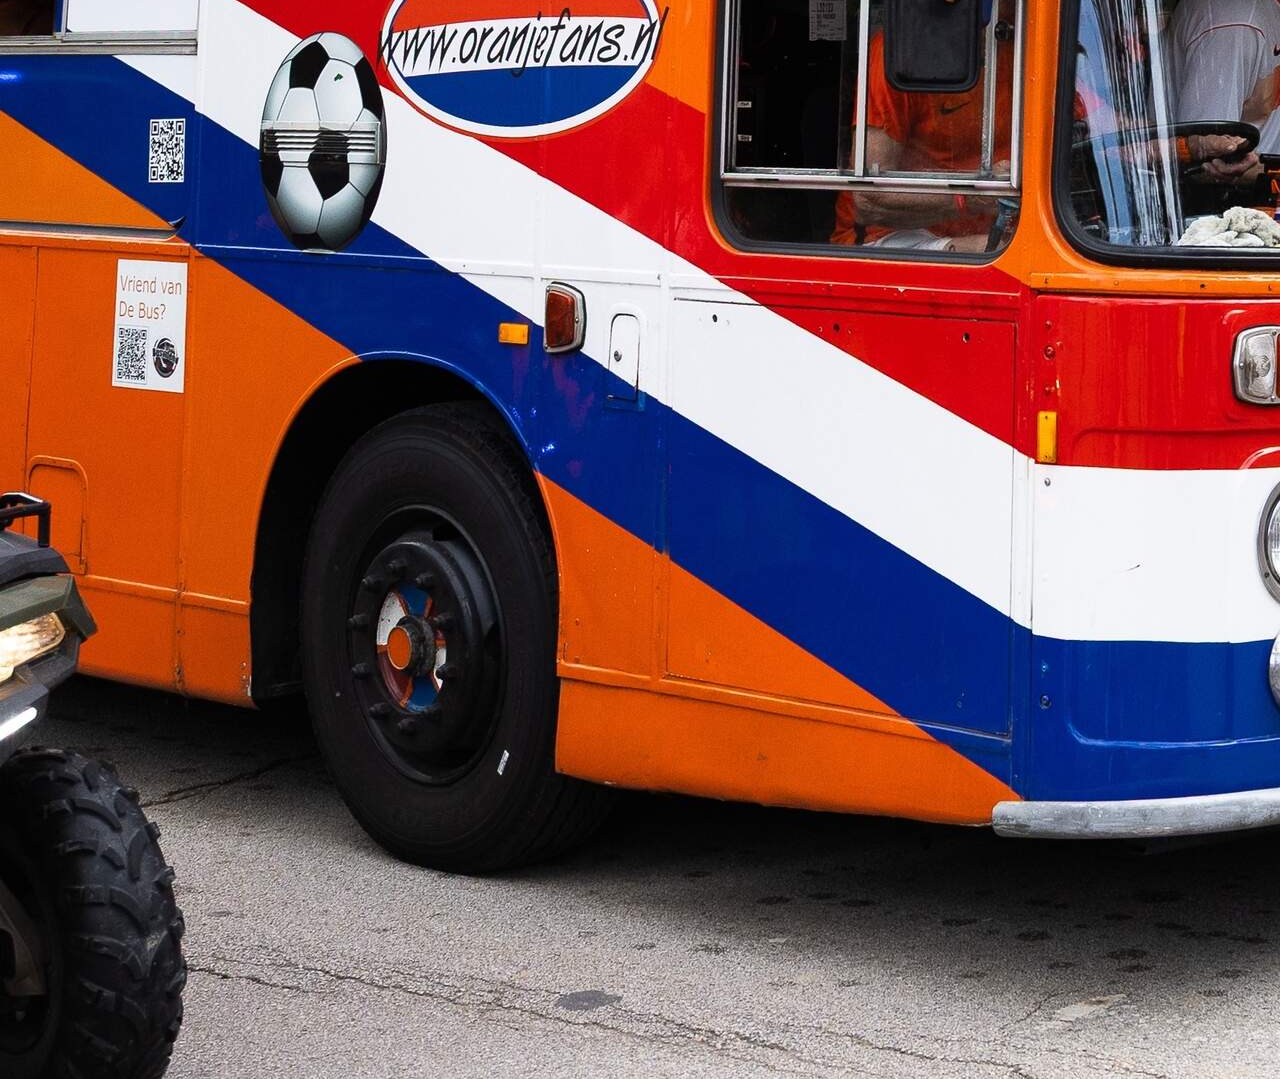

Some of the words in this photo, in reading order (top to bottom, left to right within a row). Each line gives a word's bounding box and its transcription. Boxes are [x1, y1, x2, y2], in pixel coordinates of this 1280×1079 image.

[376, 7, 669, 77] www.oranjefans.nl
[120, 275, 157, 294] Vriend
[161, 281, 182, 295] van
[119, 300, 135, 318] De
[138, 302, 166, 320] Bus?
